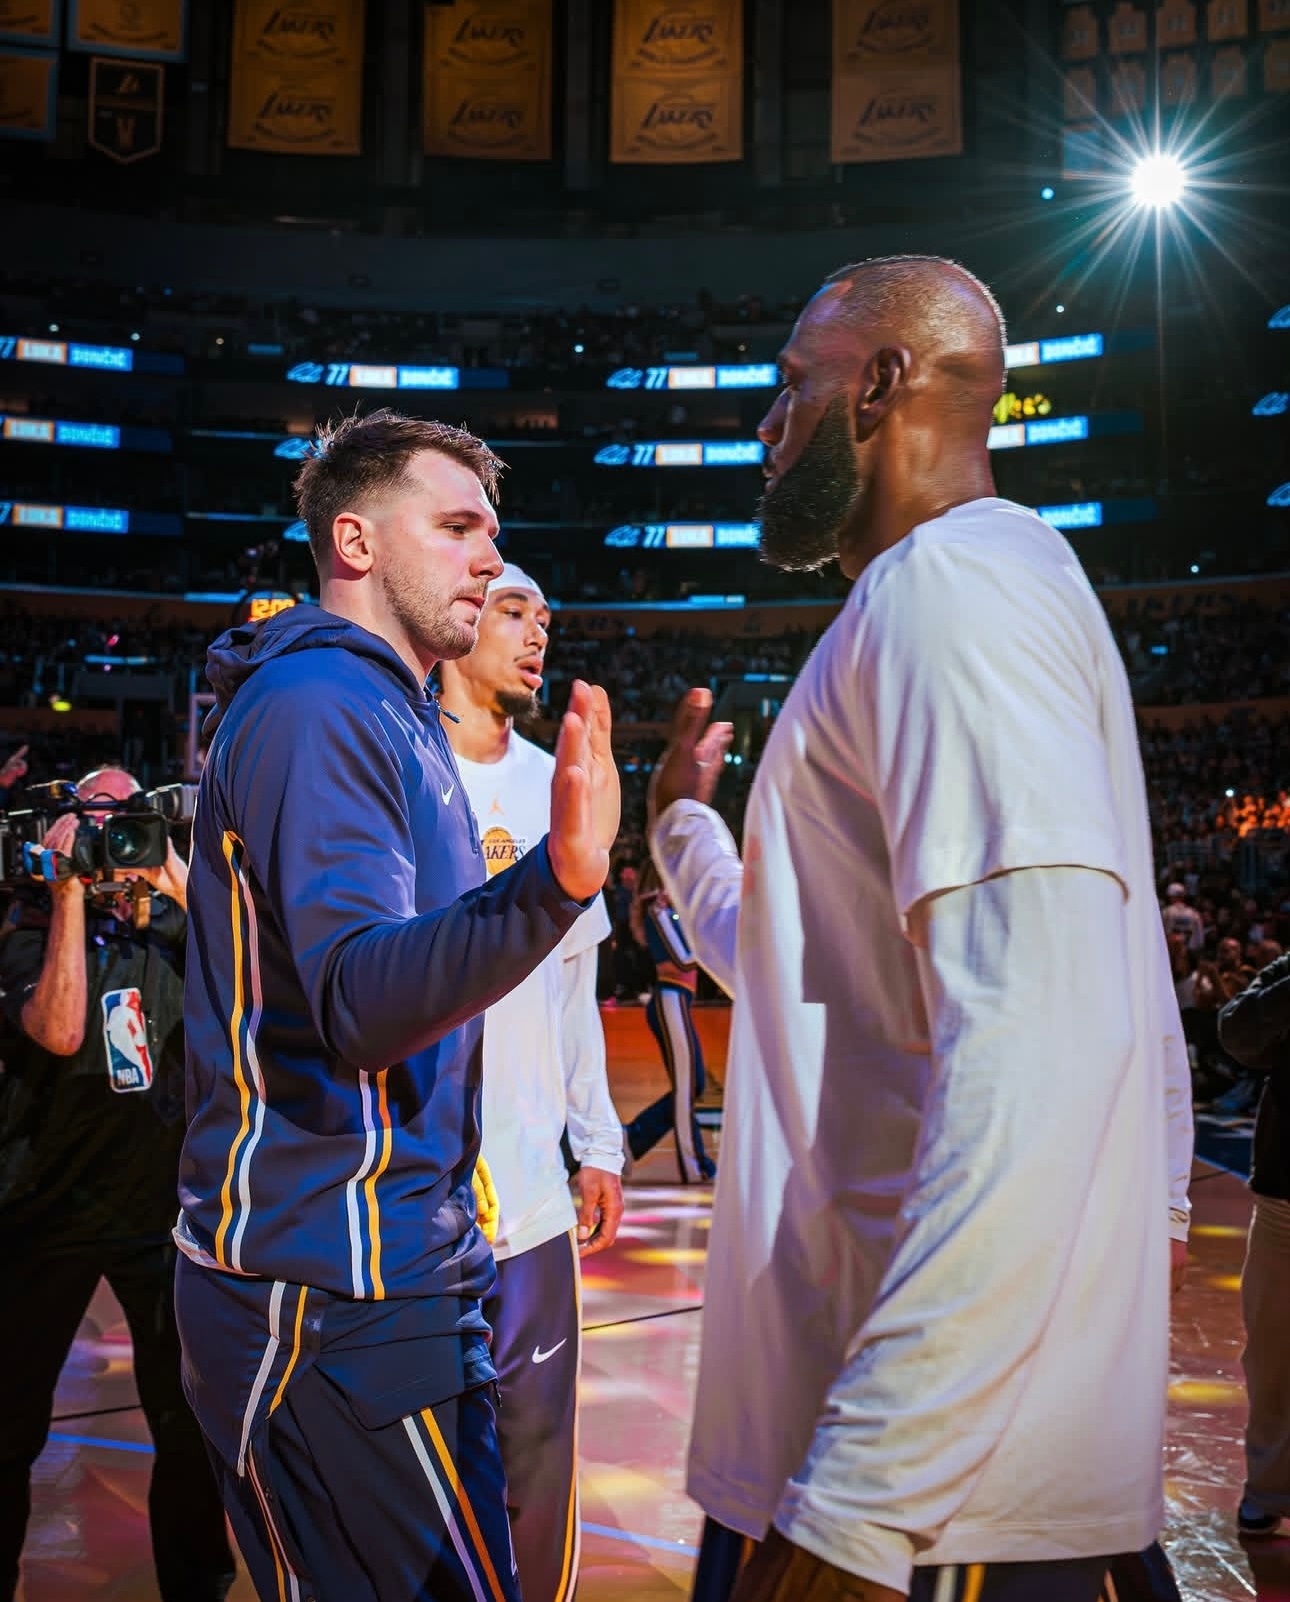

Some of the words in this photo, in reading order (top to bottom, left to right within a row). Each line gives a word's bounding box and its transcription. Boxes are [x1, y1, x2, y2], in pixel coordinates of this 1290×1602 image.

[326, 364, 349, 386] 77
[645, 366, 668, 390] 77
[632, 444, 655, 466] 77
[643, 526, 666, 548] 77
[484, 843, 526, 860] AKERS
[117, 1068, 140, 1085] NBA
